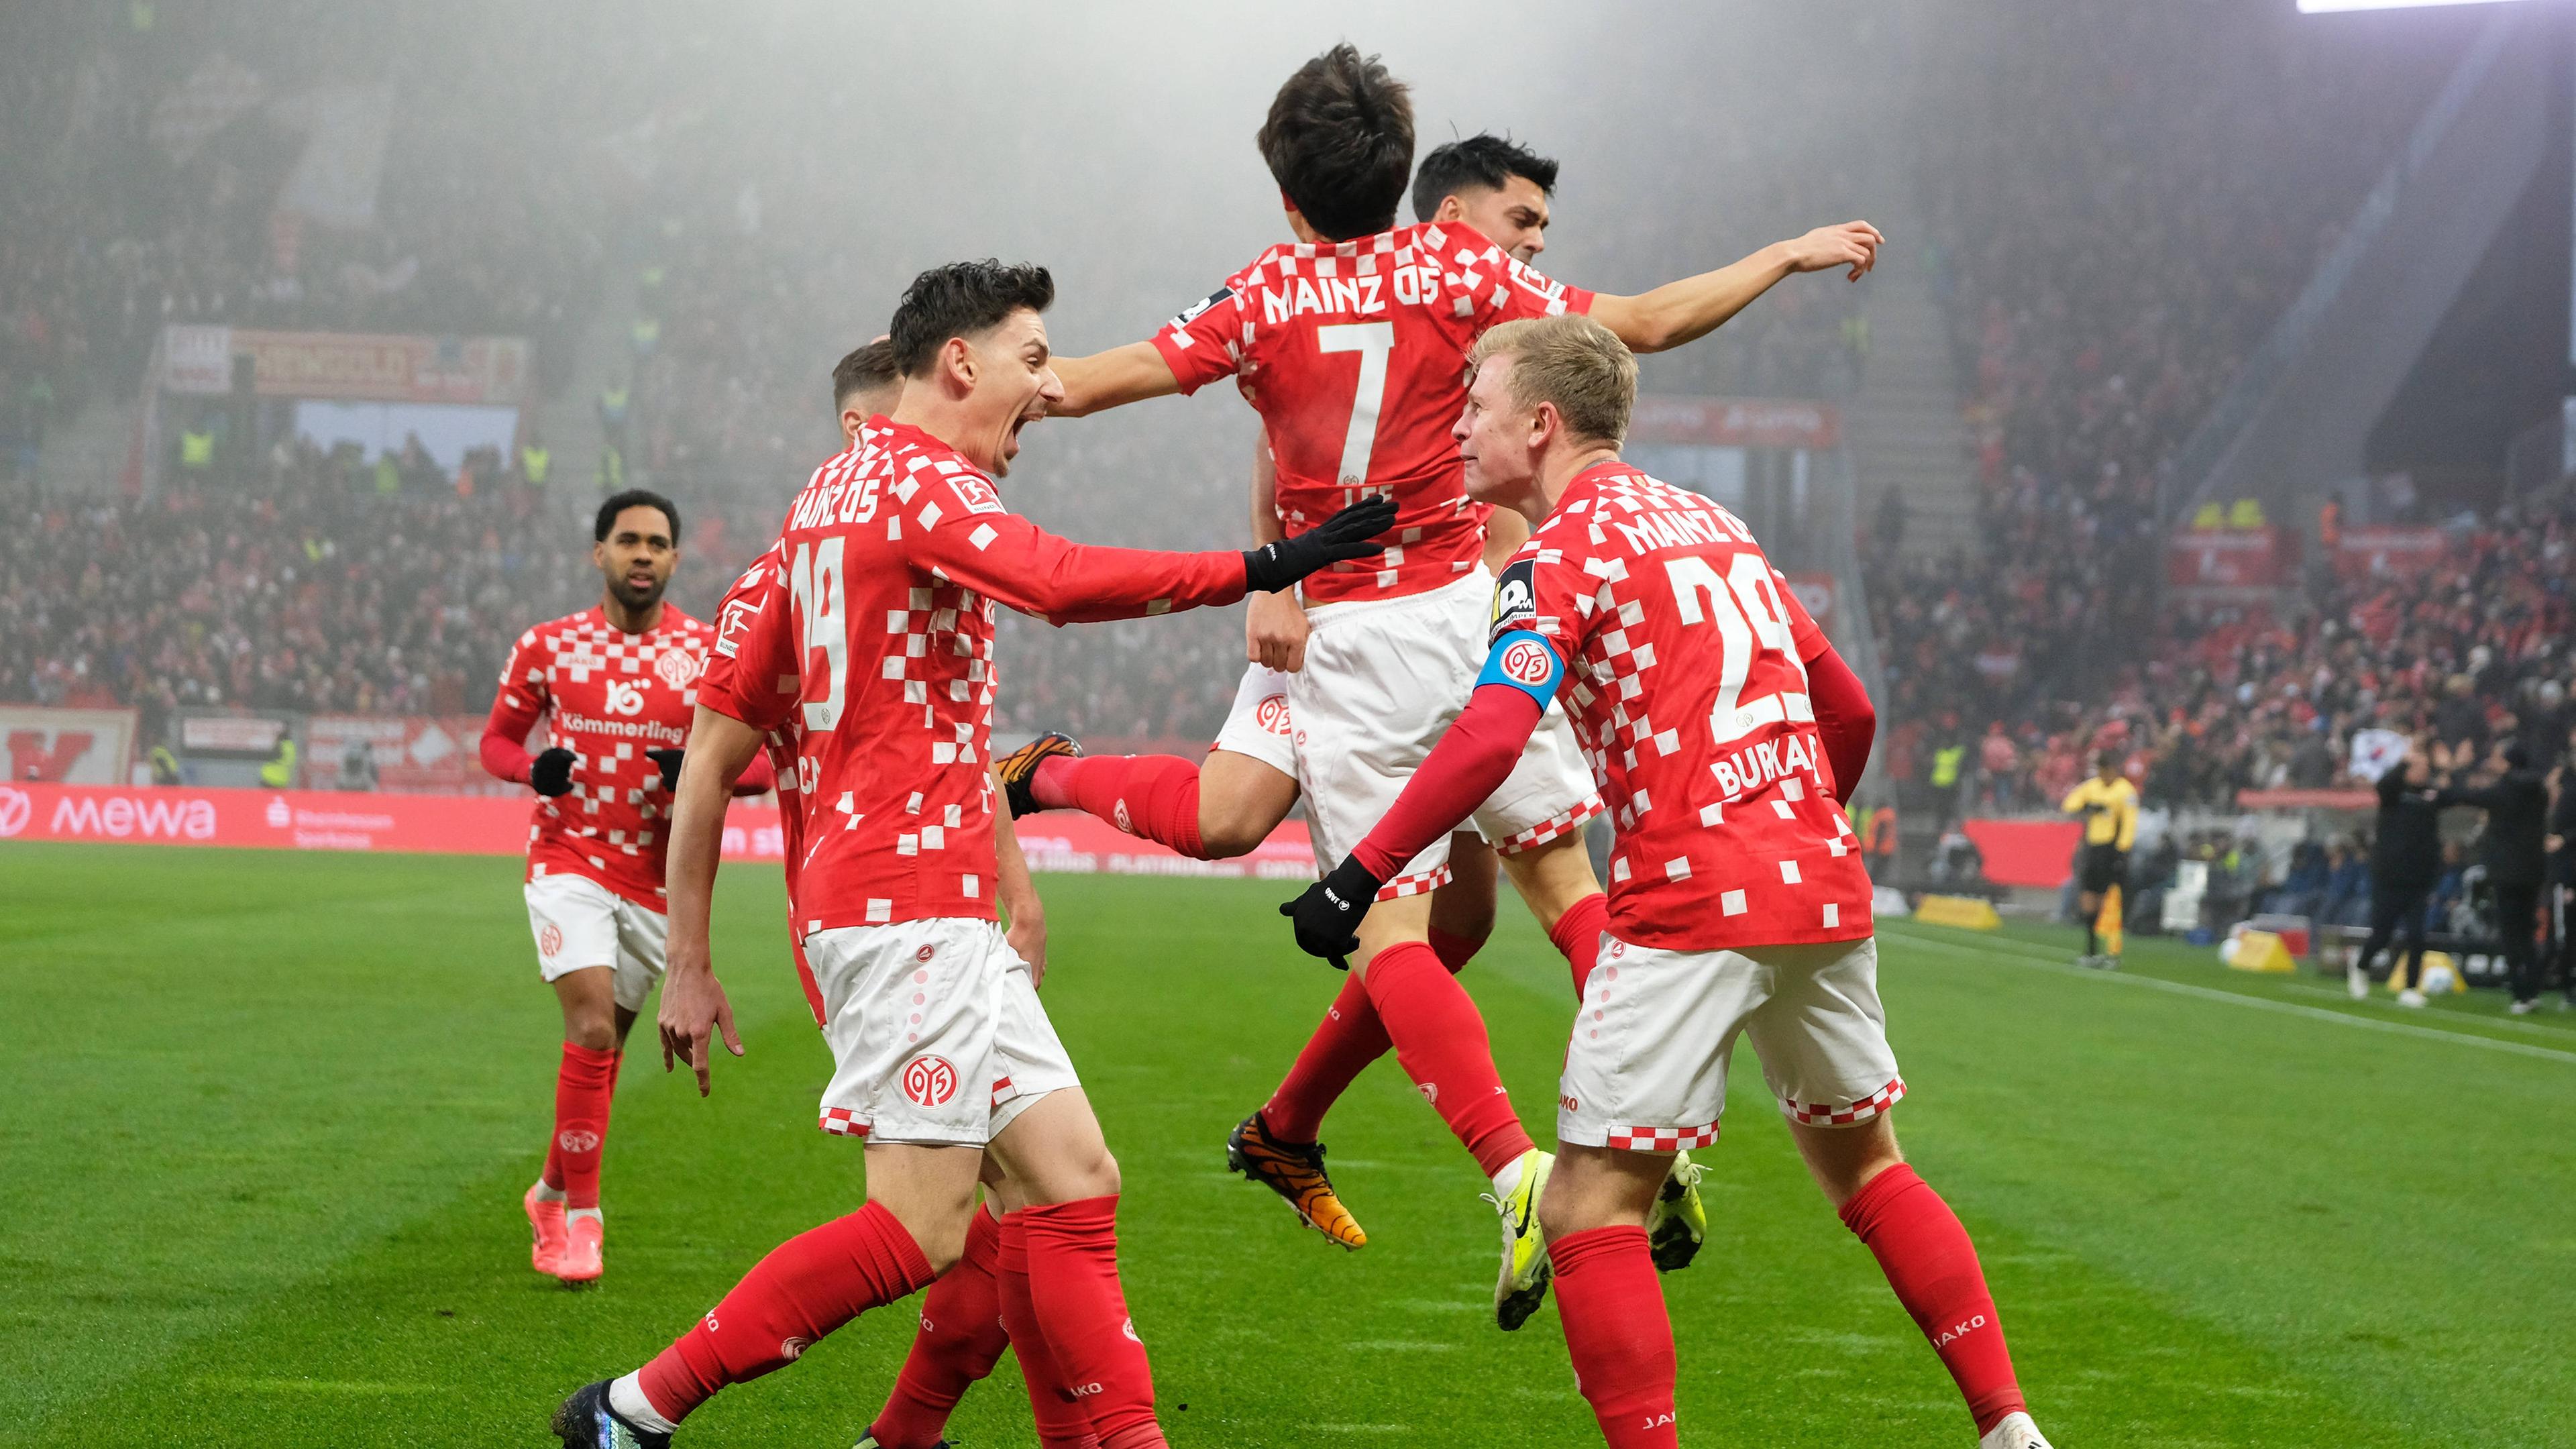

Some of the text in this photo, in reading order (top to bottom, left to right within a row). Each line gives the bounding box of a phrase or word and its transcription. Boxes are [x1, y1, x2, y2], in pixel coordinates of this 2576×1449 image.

[1261, 275, 1386, 325] MAINZ
[1393, 264, 1441, 305] 05
[1318, 321, 1395, 486] 7
[839, 478, 881, 523] 05
[1612, 508, 1758, 556] MAINZ 0
[790, 535, 848, 731] 19
[1663, 552, 1817, 745] 29
[561, 712, 684, 745] Kömmerling
[1933, 1314, 1986, 1350] JAKO
